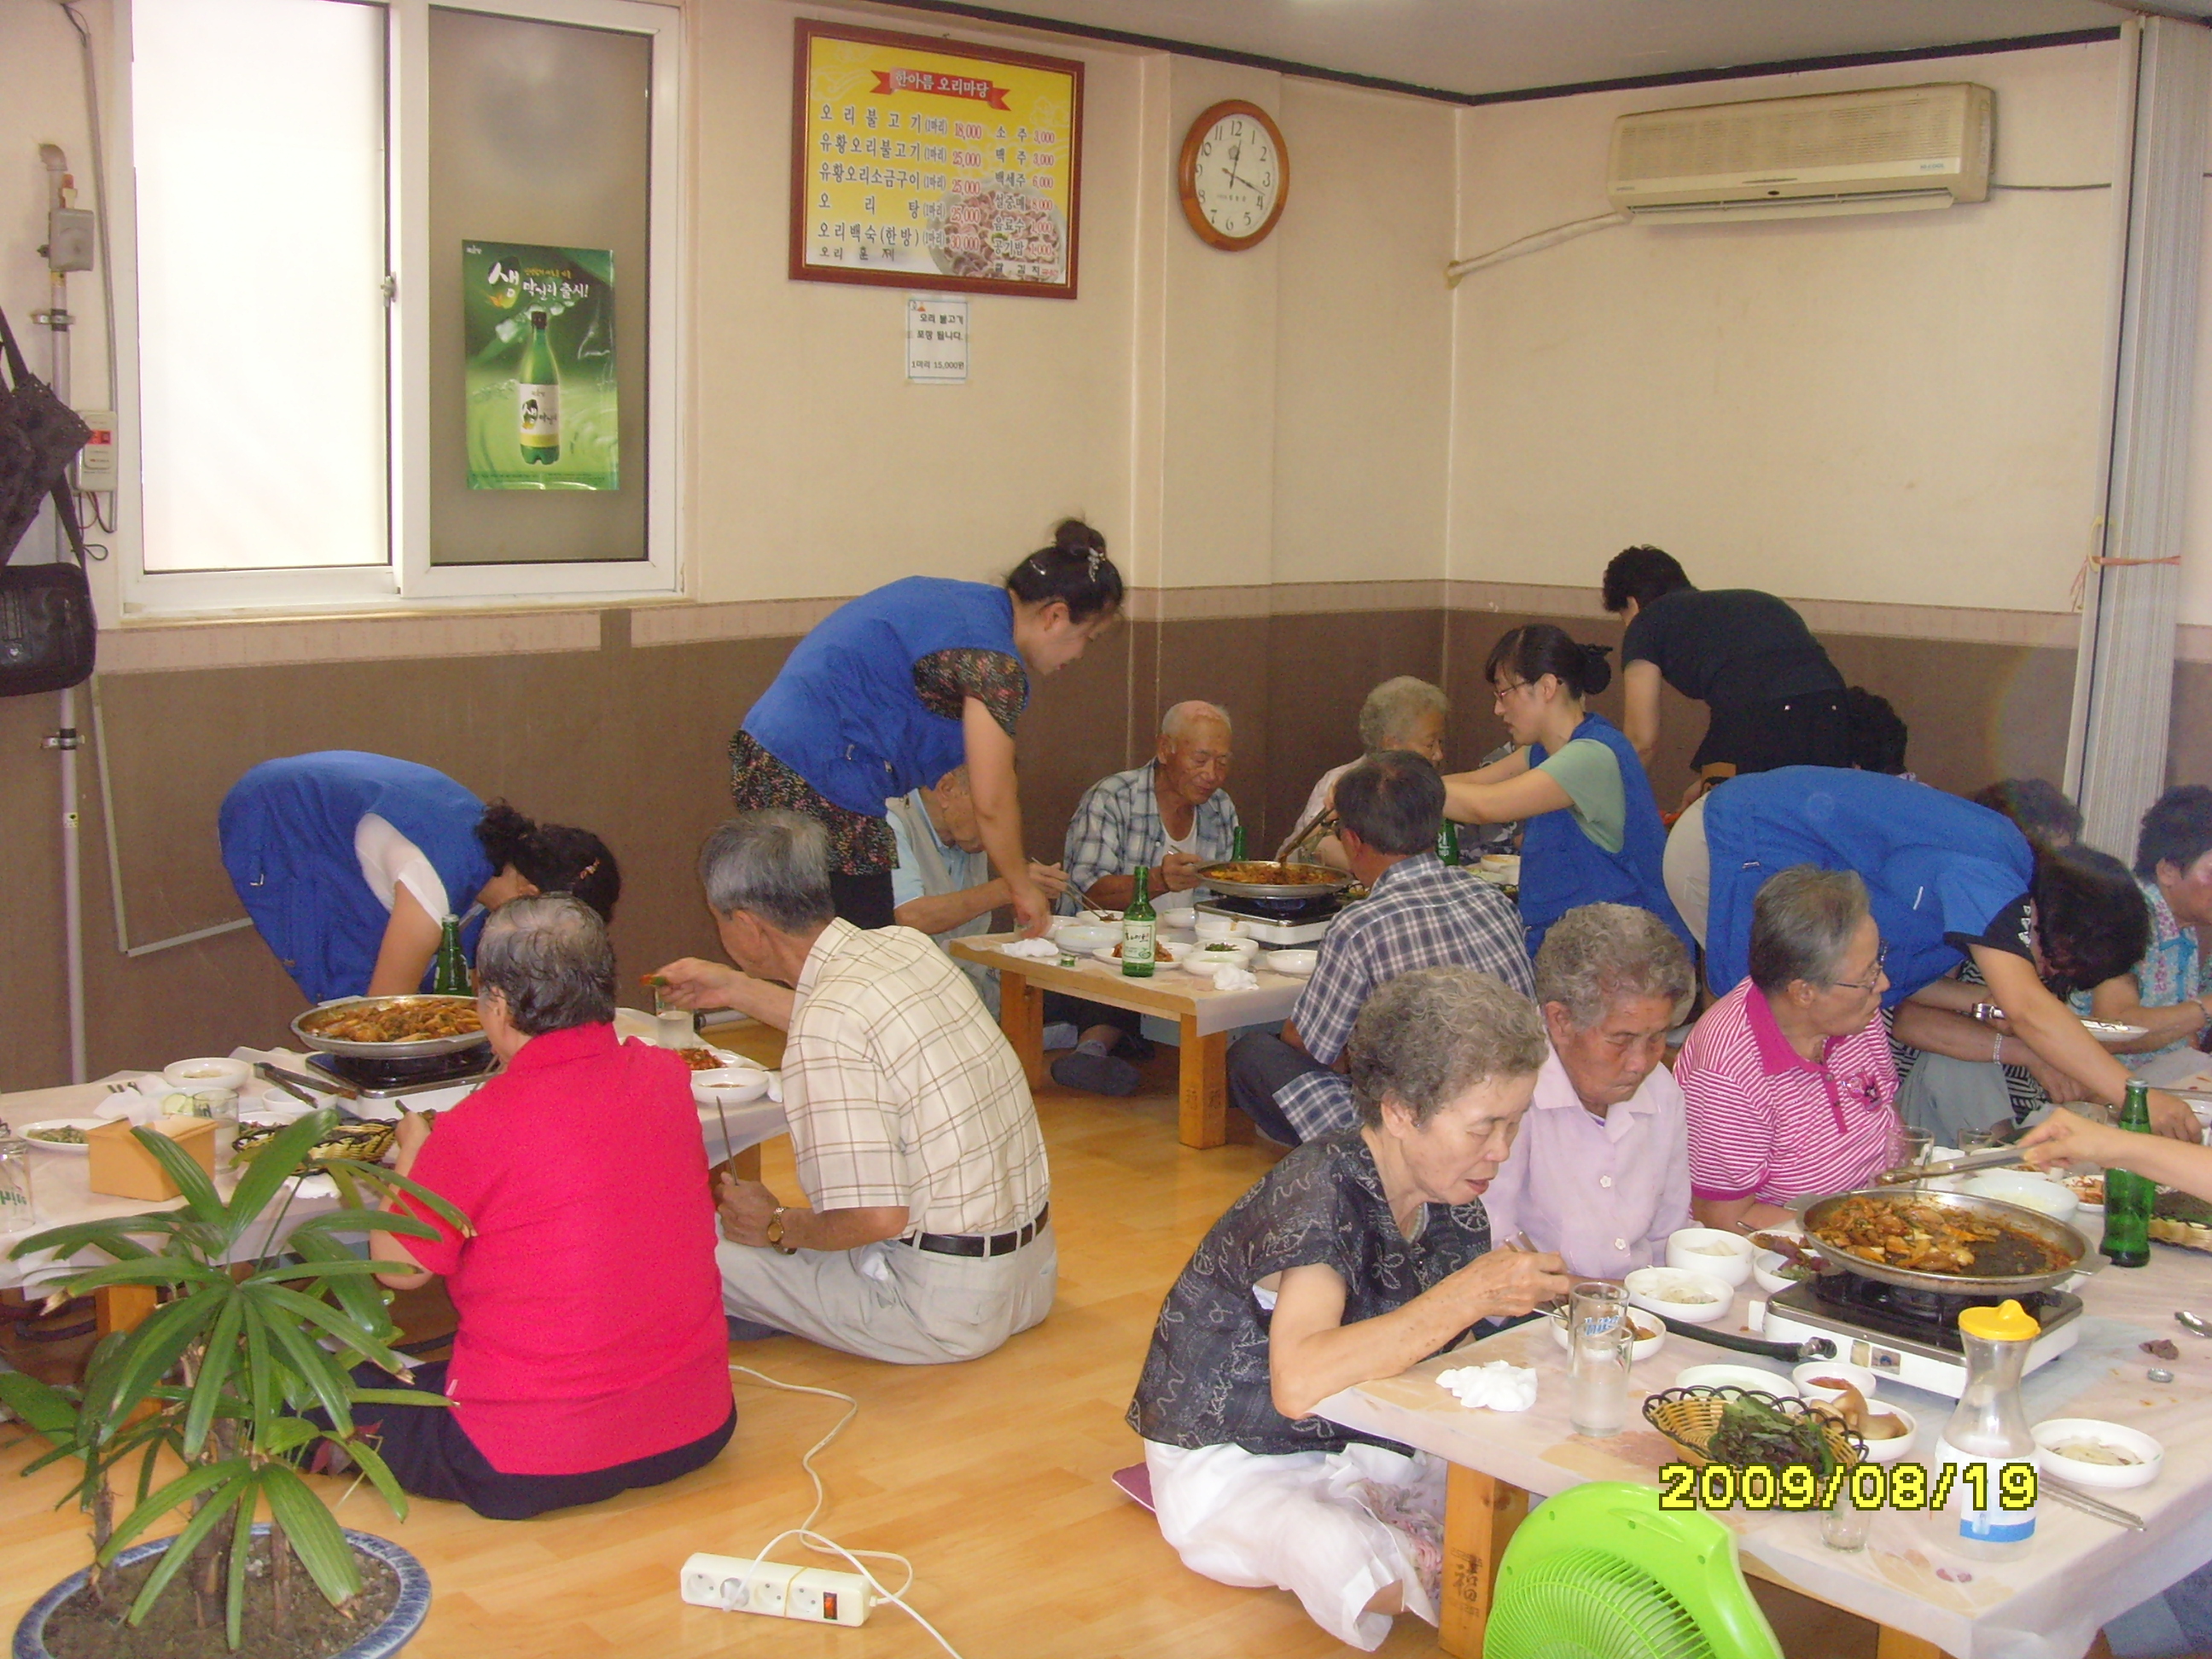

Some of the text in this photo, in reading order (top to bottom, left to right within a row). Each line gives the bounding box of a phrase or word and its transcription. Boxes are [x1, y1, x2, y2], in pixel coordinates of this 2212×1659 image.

[896, 70, 990, 99] 한아름 오리마당
[954, 123, 982, 140] 18,000
[1215, 125, 1223, 141] 11
[1231, 120, 1243, 137] 12
[1201, 142, 1212, 157] 10
[1260, 146, 1267, 161] 2
[952, 151, 981, 167] 25,000
[819, 161, 920, 191] 유황오리소금구이
[952, 178, 981, 195] 25,000
[1196, 163, 1203, 178] 9
[995, 171, 1026, 189] 백세주
[1263, 172, 1271, 188] 3
[1198, 189, 1206, 205] 8
[1257, 195, 1264, 211] 4
[951, 206, 981, 224] 25,000
[1210, 209, 1218, 224] 7
[1243, 212, 1251, 225] 5
[993, 216, 1025, 233] 음료수
[1225, 216, 1234, 231] 6
[950, 234, 980, 251] 30,000
[993, 240, 1024, 256] 공기밥
[560, 282, 589, 299] 출시!
[920, 313, 963, 324] 오리 불고기
[917, 329, 933, 341] 포장
